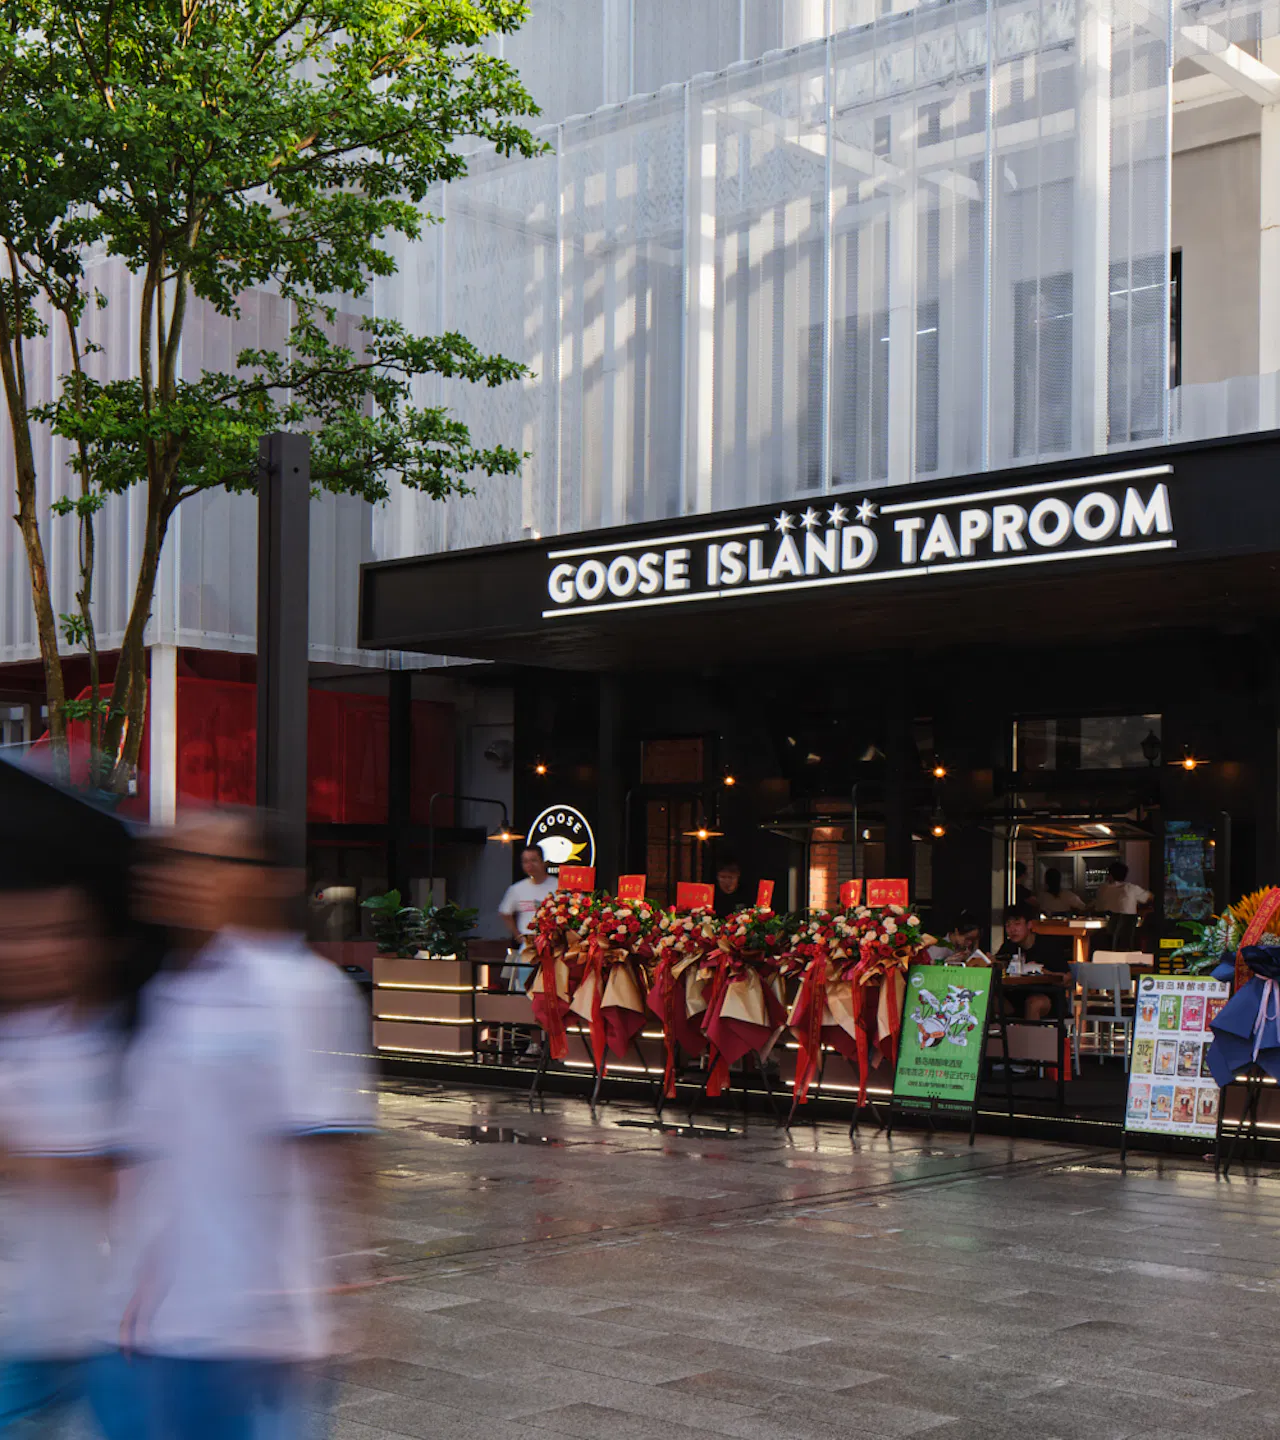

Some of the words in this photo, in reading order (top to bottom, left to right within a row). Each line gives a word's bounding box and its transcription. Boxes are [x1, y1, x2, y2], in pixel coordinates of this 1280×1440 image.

[548, 548, 690, 603] GOOSE
[707, 525, 878, 587] ISLAND
[894, 482, 1173, 563] TAPROOM
[539, 812, 582, 834] GOOSE
